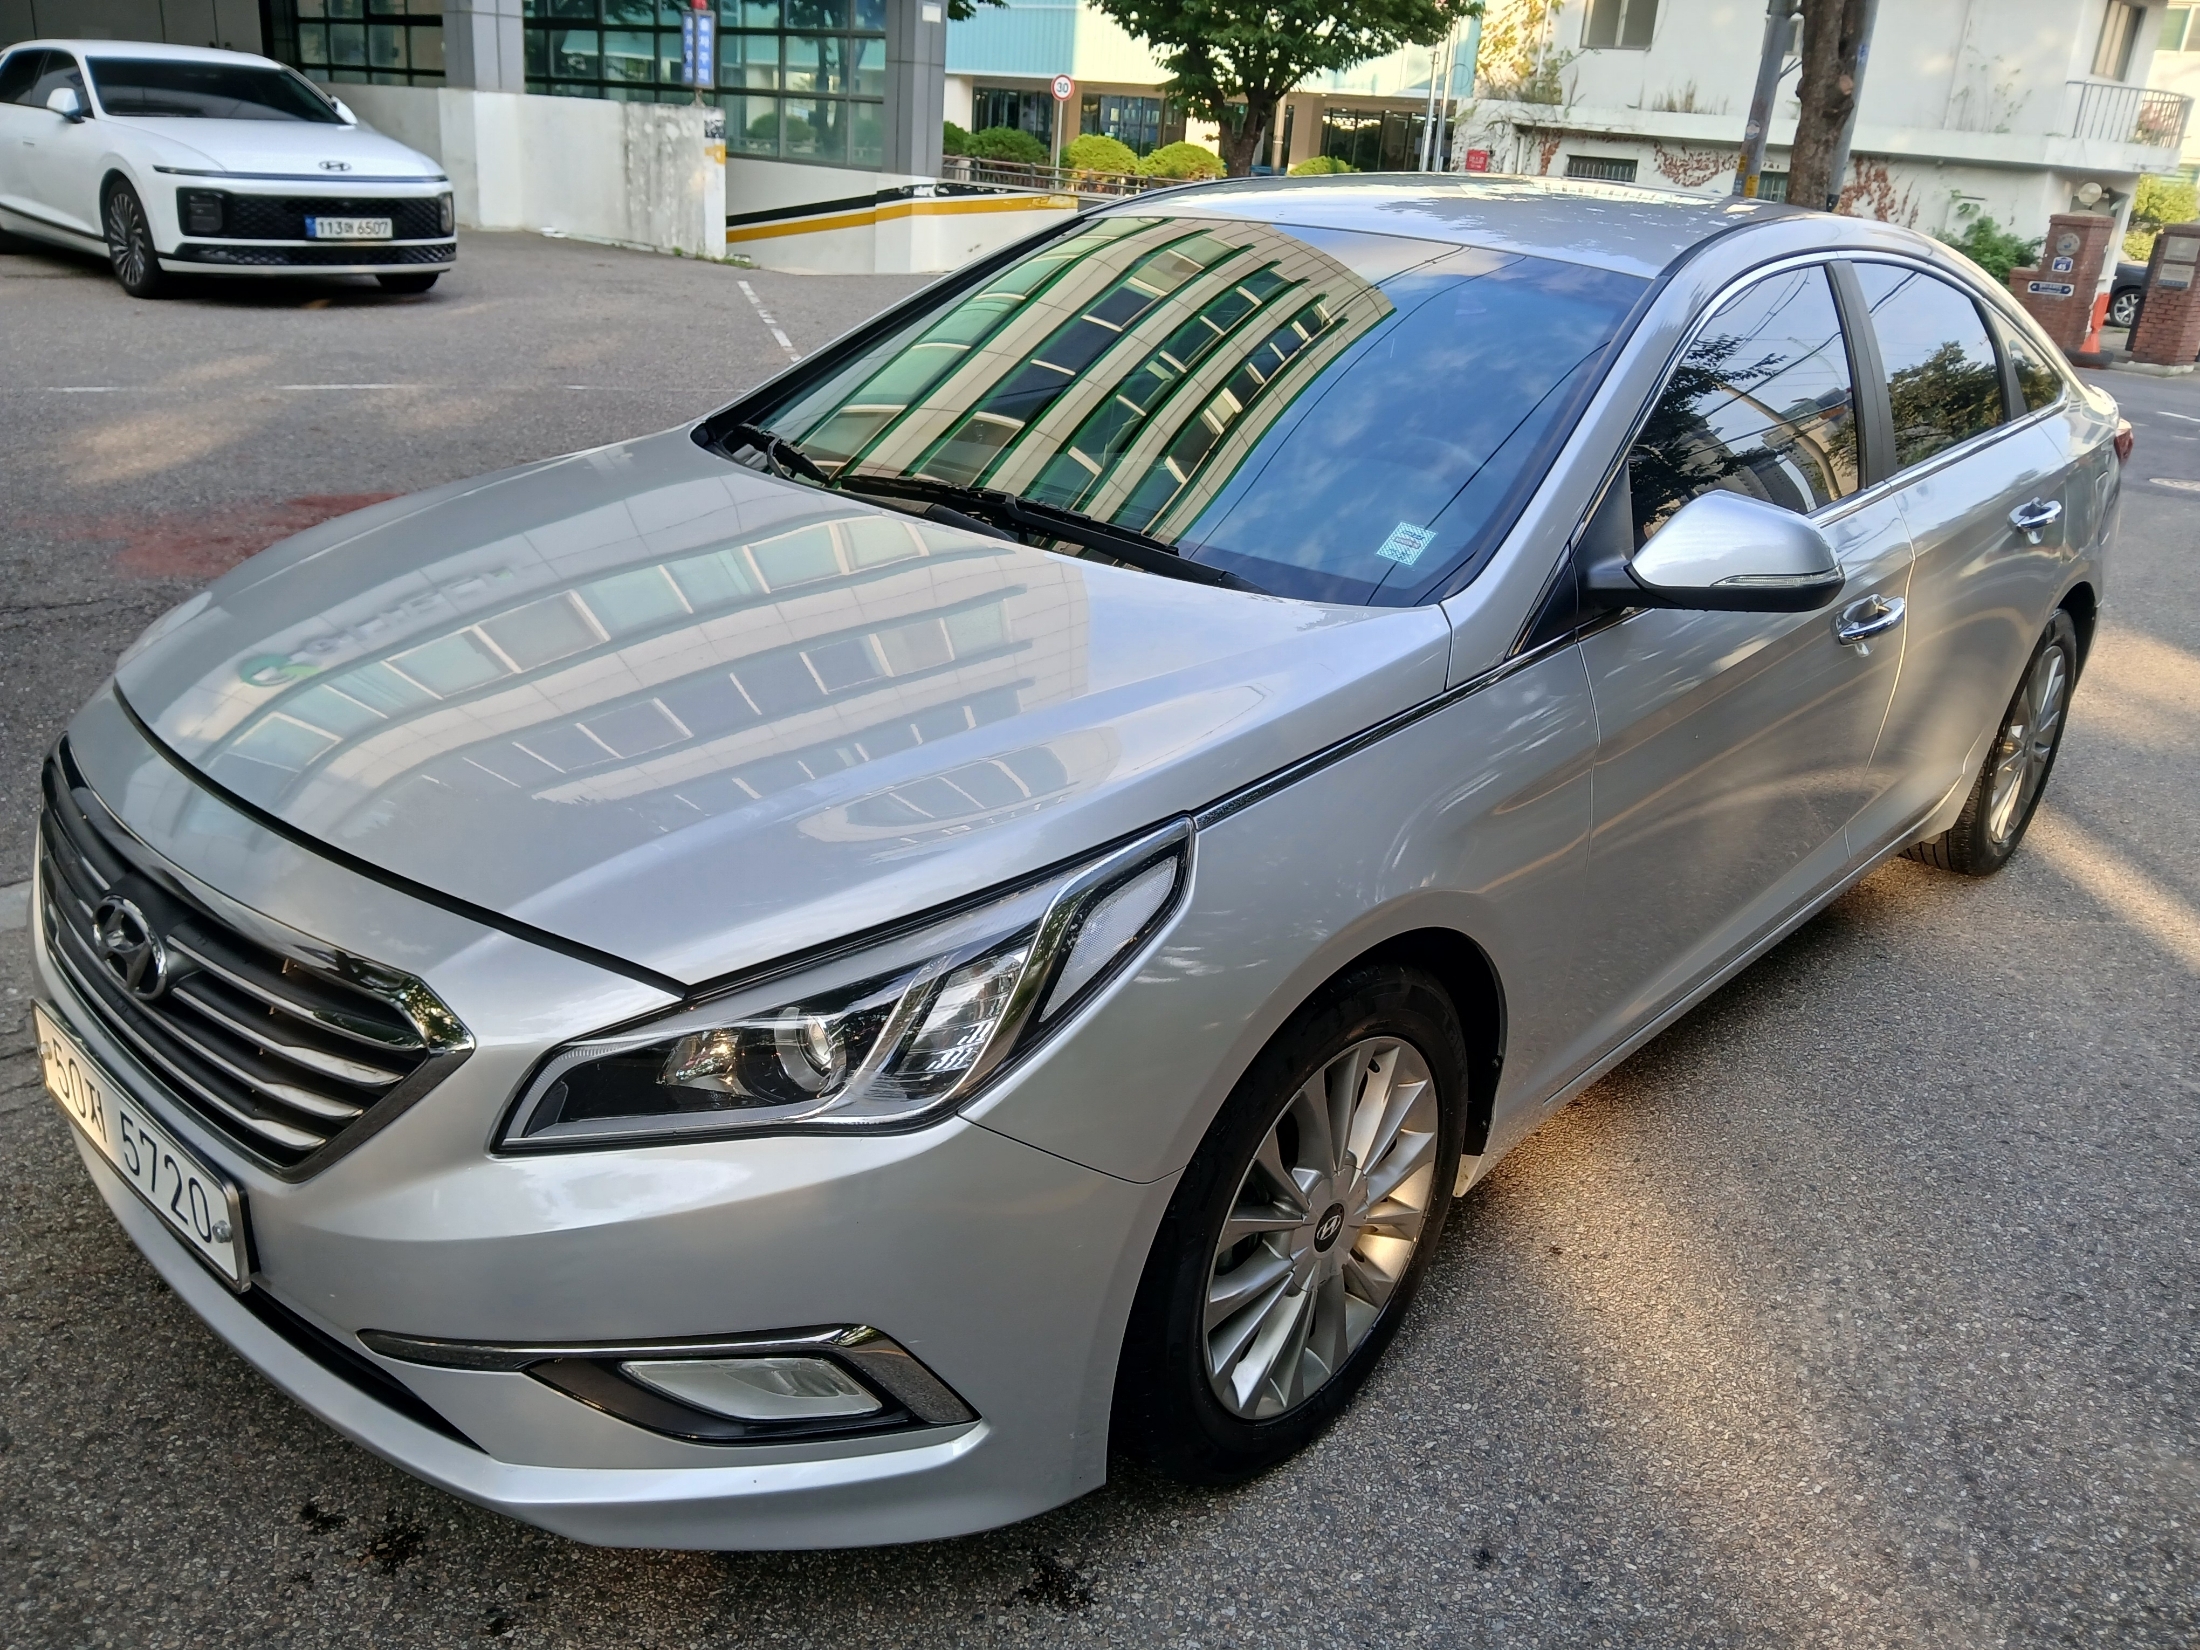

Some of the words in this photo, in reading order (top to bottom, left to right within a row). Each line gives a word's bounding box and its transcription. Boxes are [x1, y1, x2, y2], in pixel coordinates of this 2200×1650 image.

[1056, 82, 1069, 93] 30
[357, 221, 388, 235] 6507
[53, 1037, 108, 1143] 50저
[120, 1109, 212, 1244] 5720
